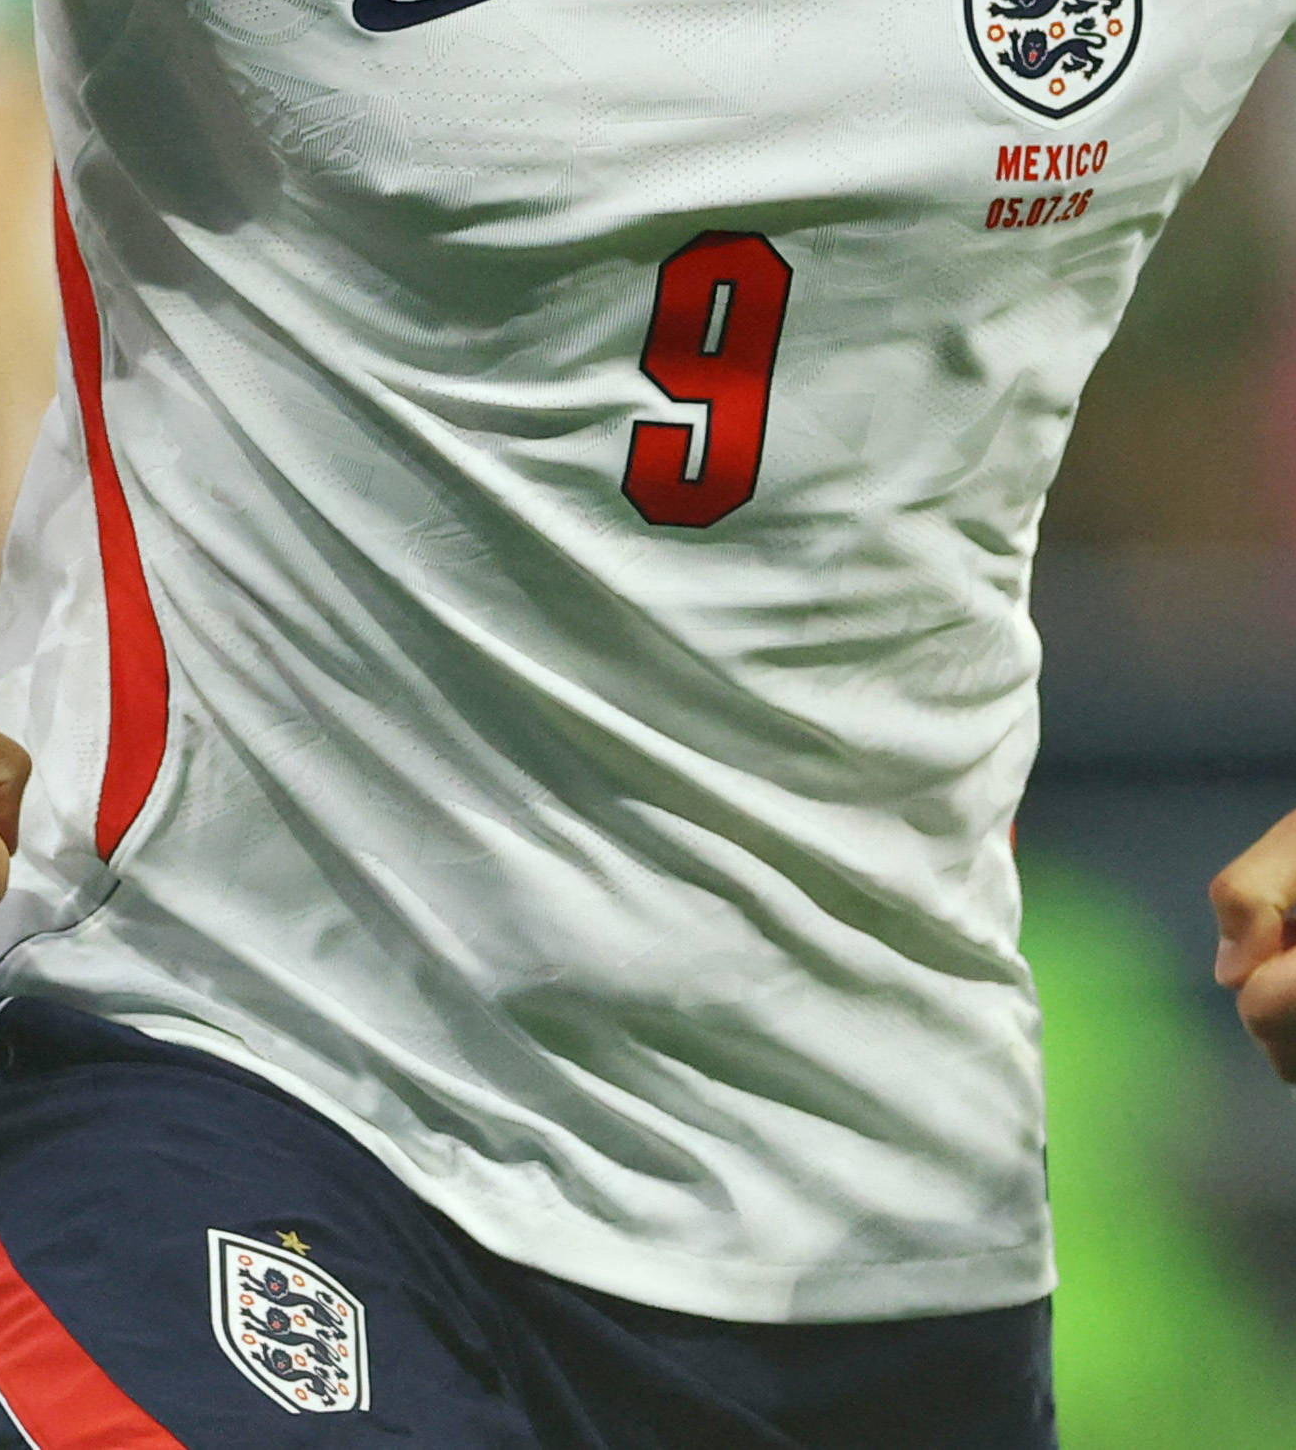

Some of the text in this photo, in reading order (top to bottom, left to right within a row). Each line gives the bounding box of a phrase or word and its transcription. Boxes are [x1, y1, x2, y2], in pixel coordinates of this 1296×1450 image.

[996, 140, 1108, 182] MEXICO
[985, 188, 1094, 229] 05.07.26
[621, 230, 794, 528] 9
